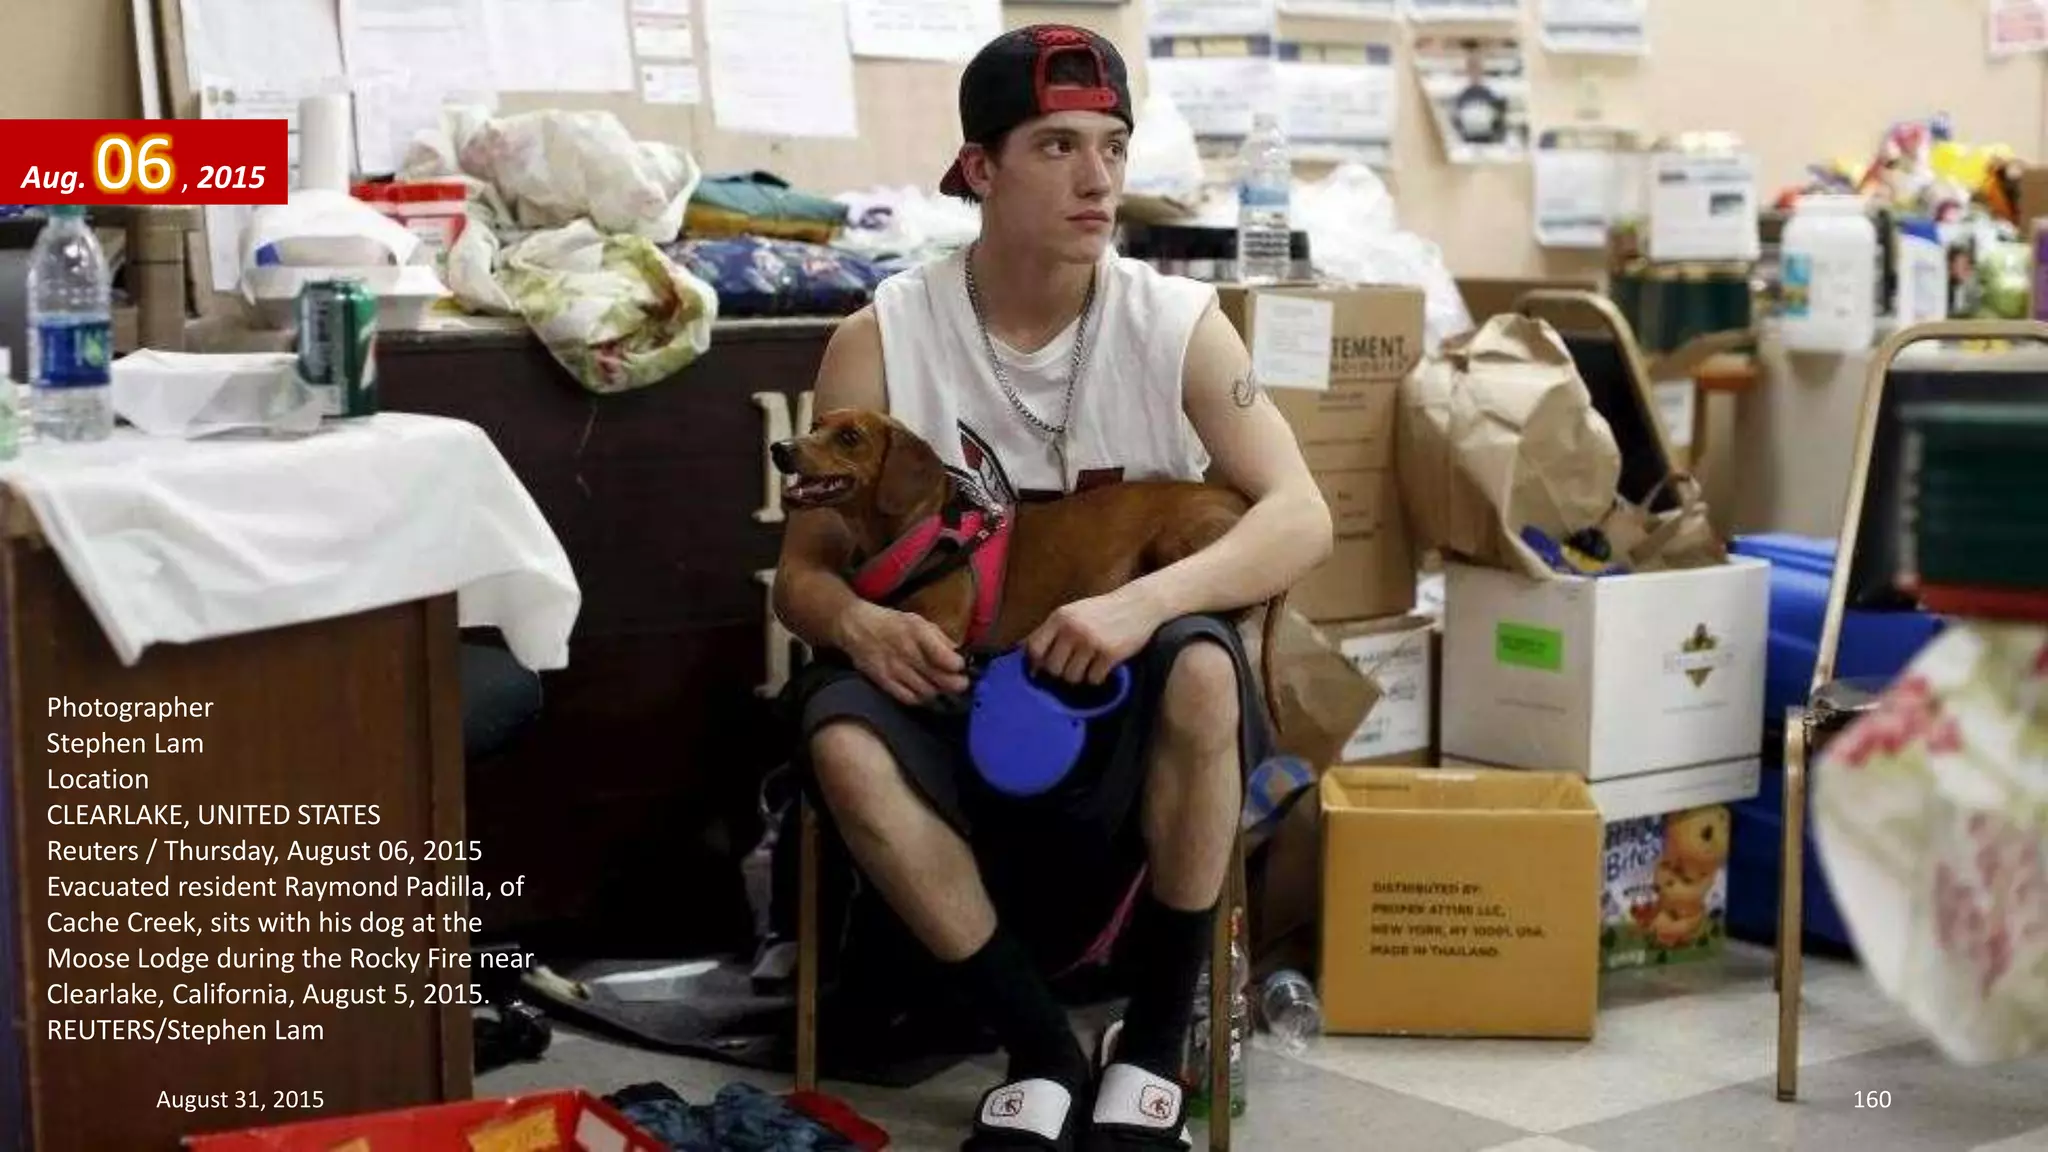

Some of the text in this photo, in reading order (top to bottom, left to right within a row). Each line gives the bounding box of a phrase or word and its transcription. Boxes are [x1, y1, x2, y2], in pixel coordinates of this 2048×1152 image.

[1371, 881, 1460, 895] DISTRIBUTED
[1370, 923, 1403, 936] NEW
[1448, 925, 1469, 937] NY
[1370, 944, 1409, 957] MADE
[1413, 945, 1428, 957] IN
